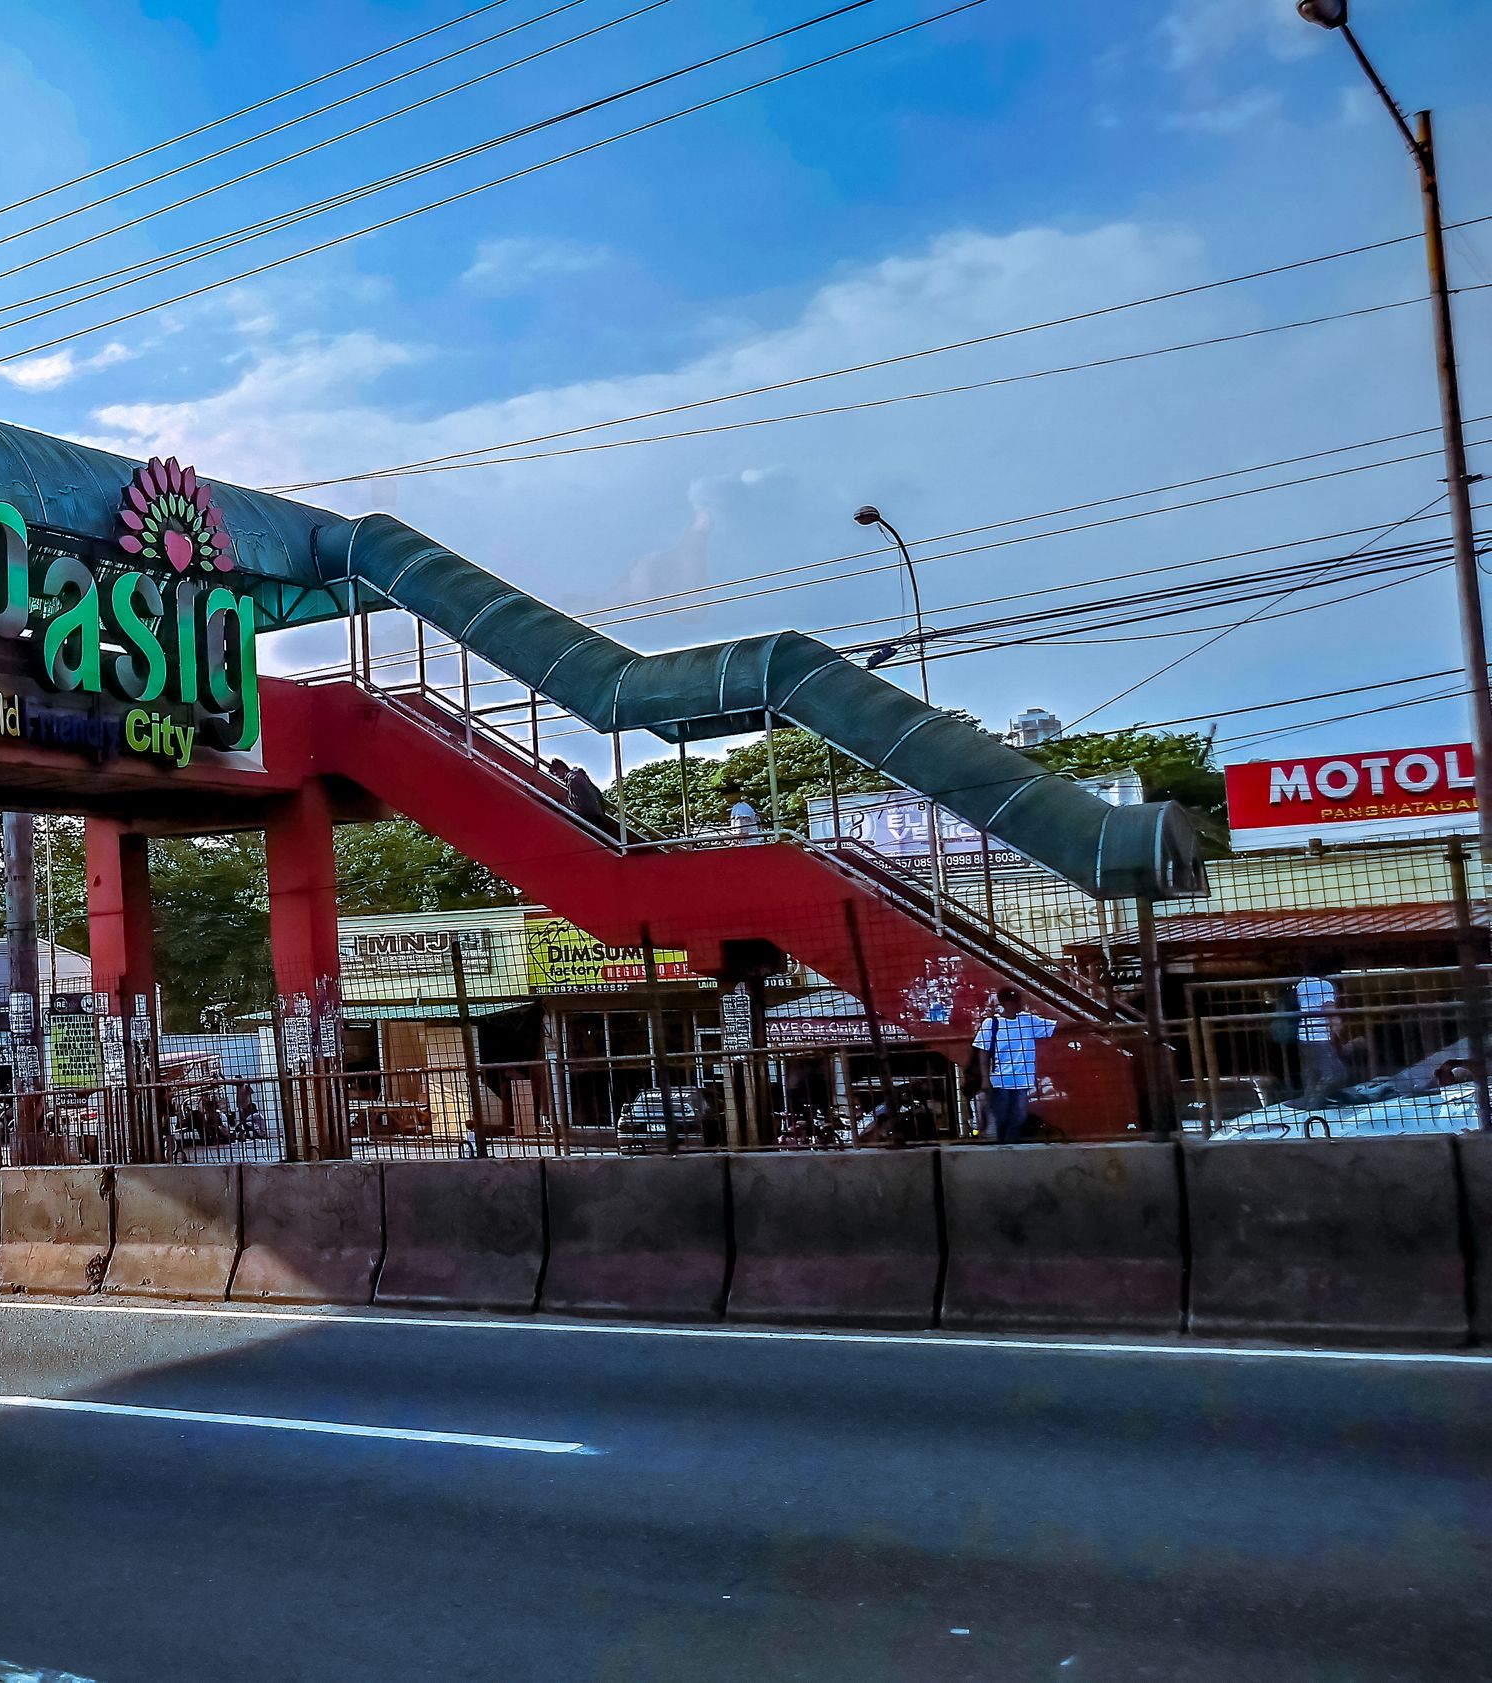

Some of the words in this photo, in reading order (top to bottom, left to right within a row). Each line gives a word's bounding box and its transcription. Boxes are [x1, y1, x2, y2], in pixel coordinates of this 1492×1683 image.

[124, 707, 195, 769] City
[946, 855, 972, 866] 0998
[367, 931, 450, 955] MNJ
[547, 943, 644, 963] DIMSUM
[549, 965, 602, 978] factory
[607, 964, 666, 978] NEGOSO
